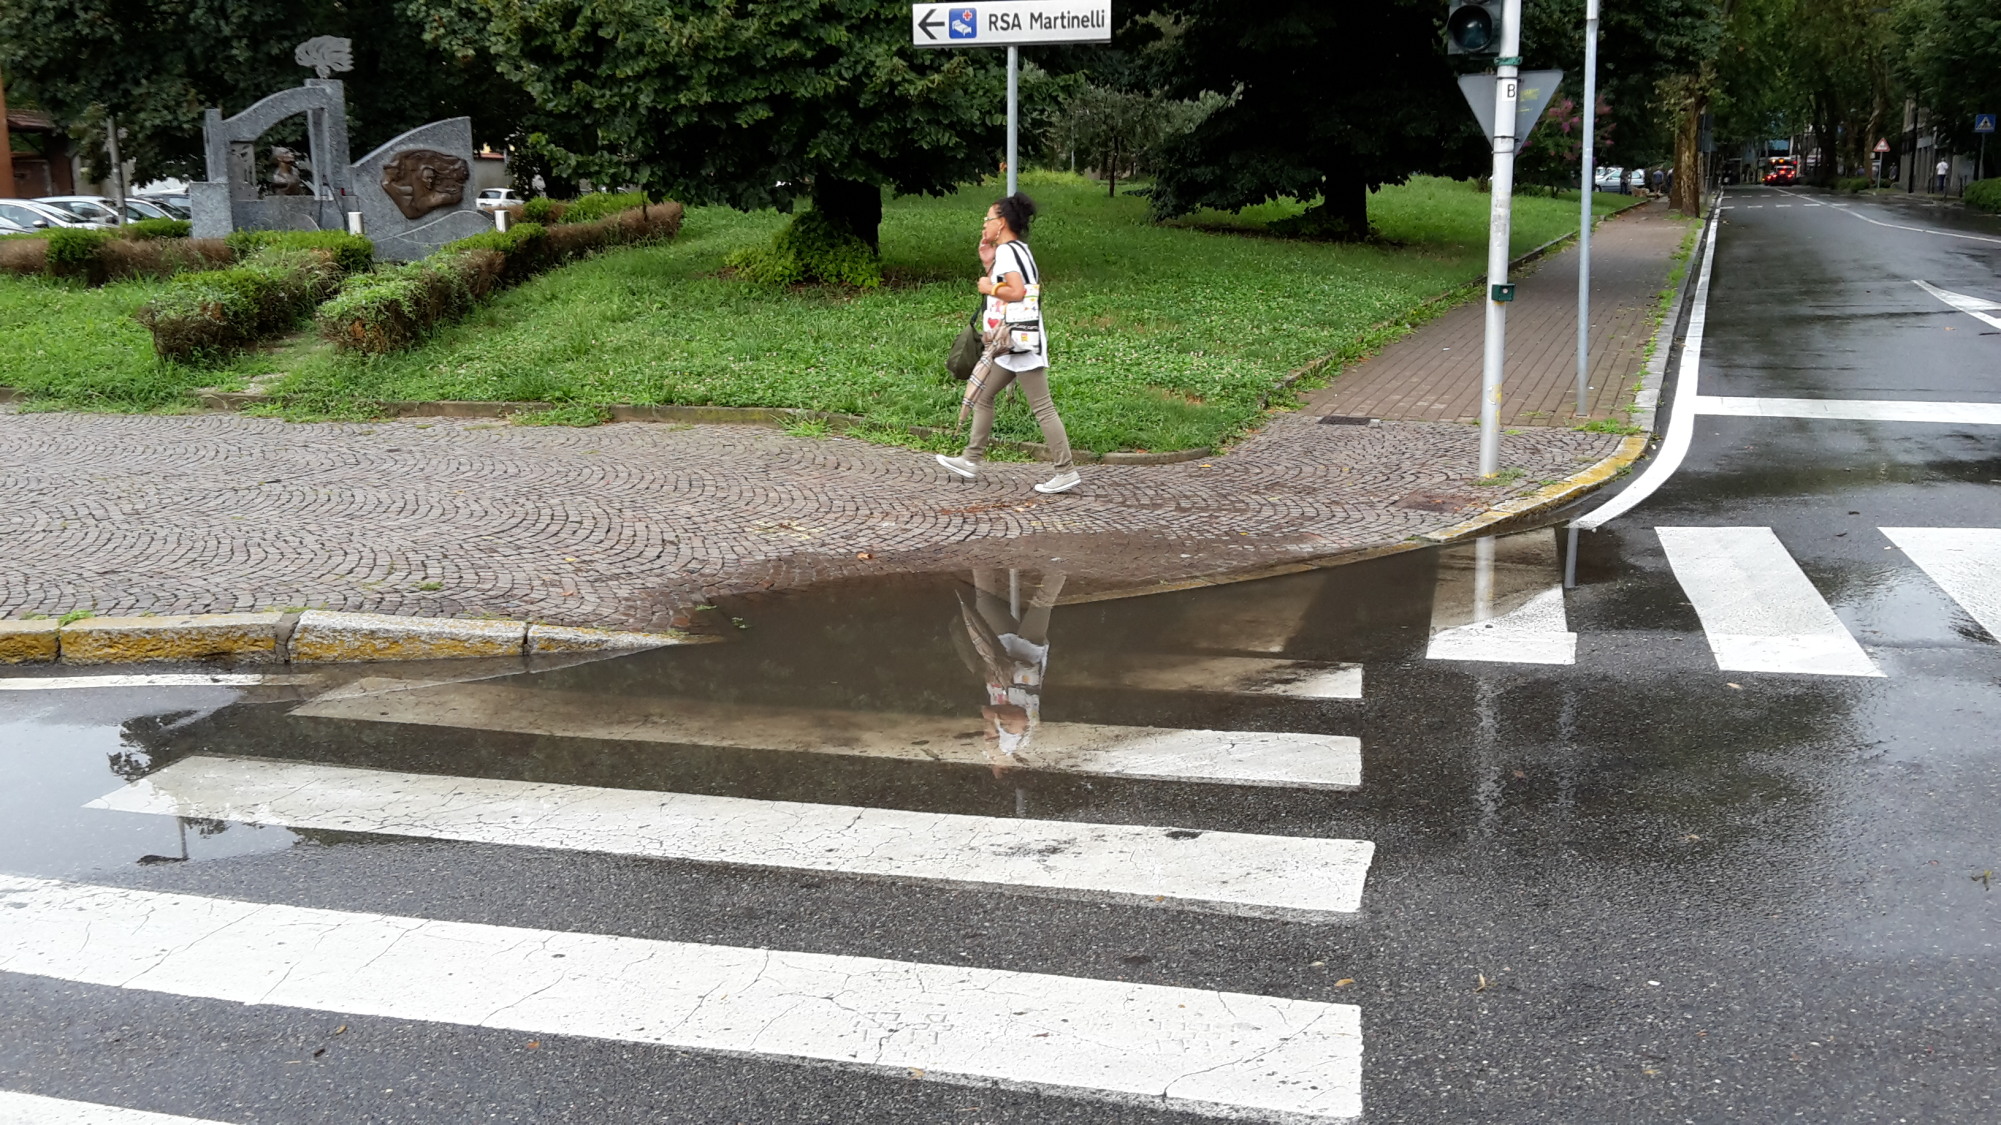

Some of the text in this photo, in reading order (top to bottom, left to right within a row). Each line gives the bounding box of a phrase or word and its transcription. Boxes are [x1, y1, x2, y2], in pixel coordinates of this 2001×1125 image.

[988, 9, 1105, 32] RSA Martinelli
[1507, 84, 1516, 98] B
